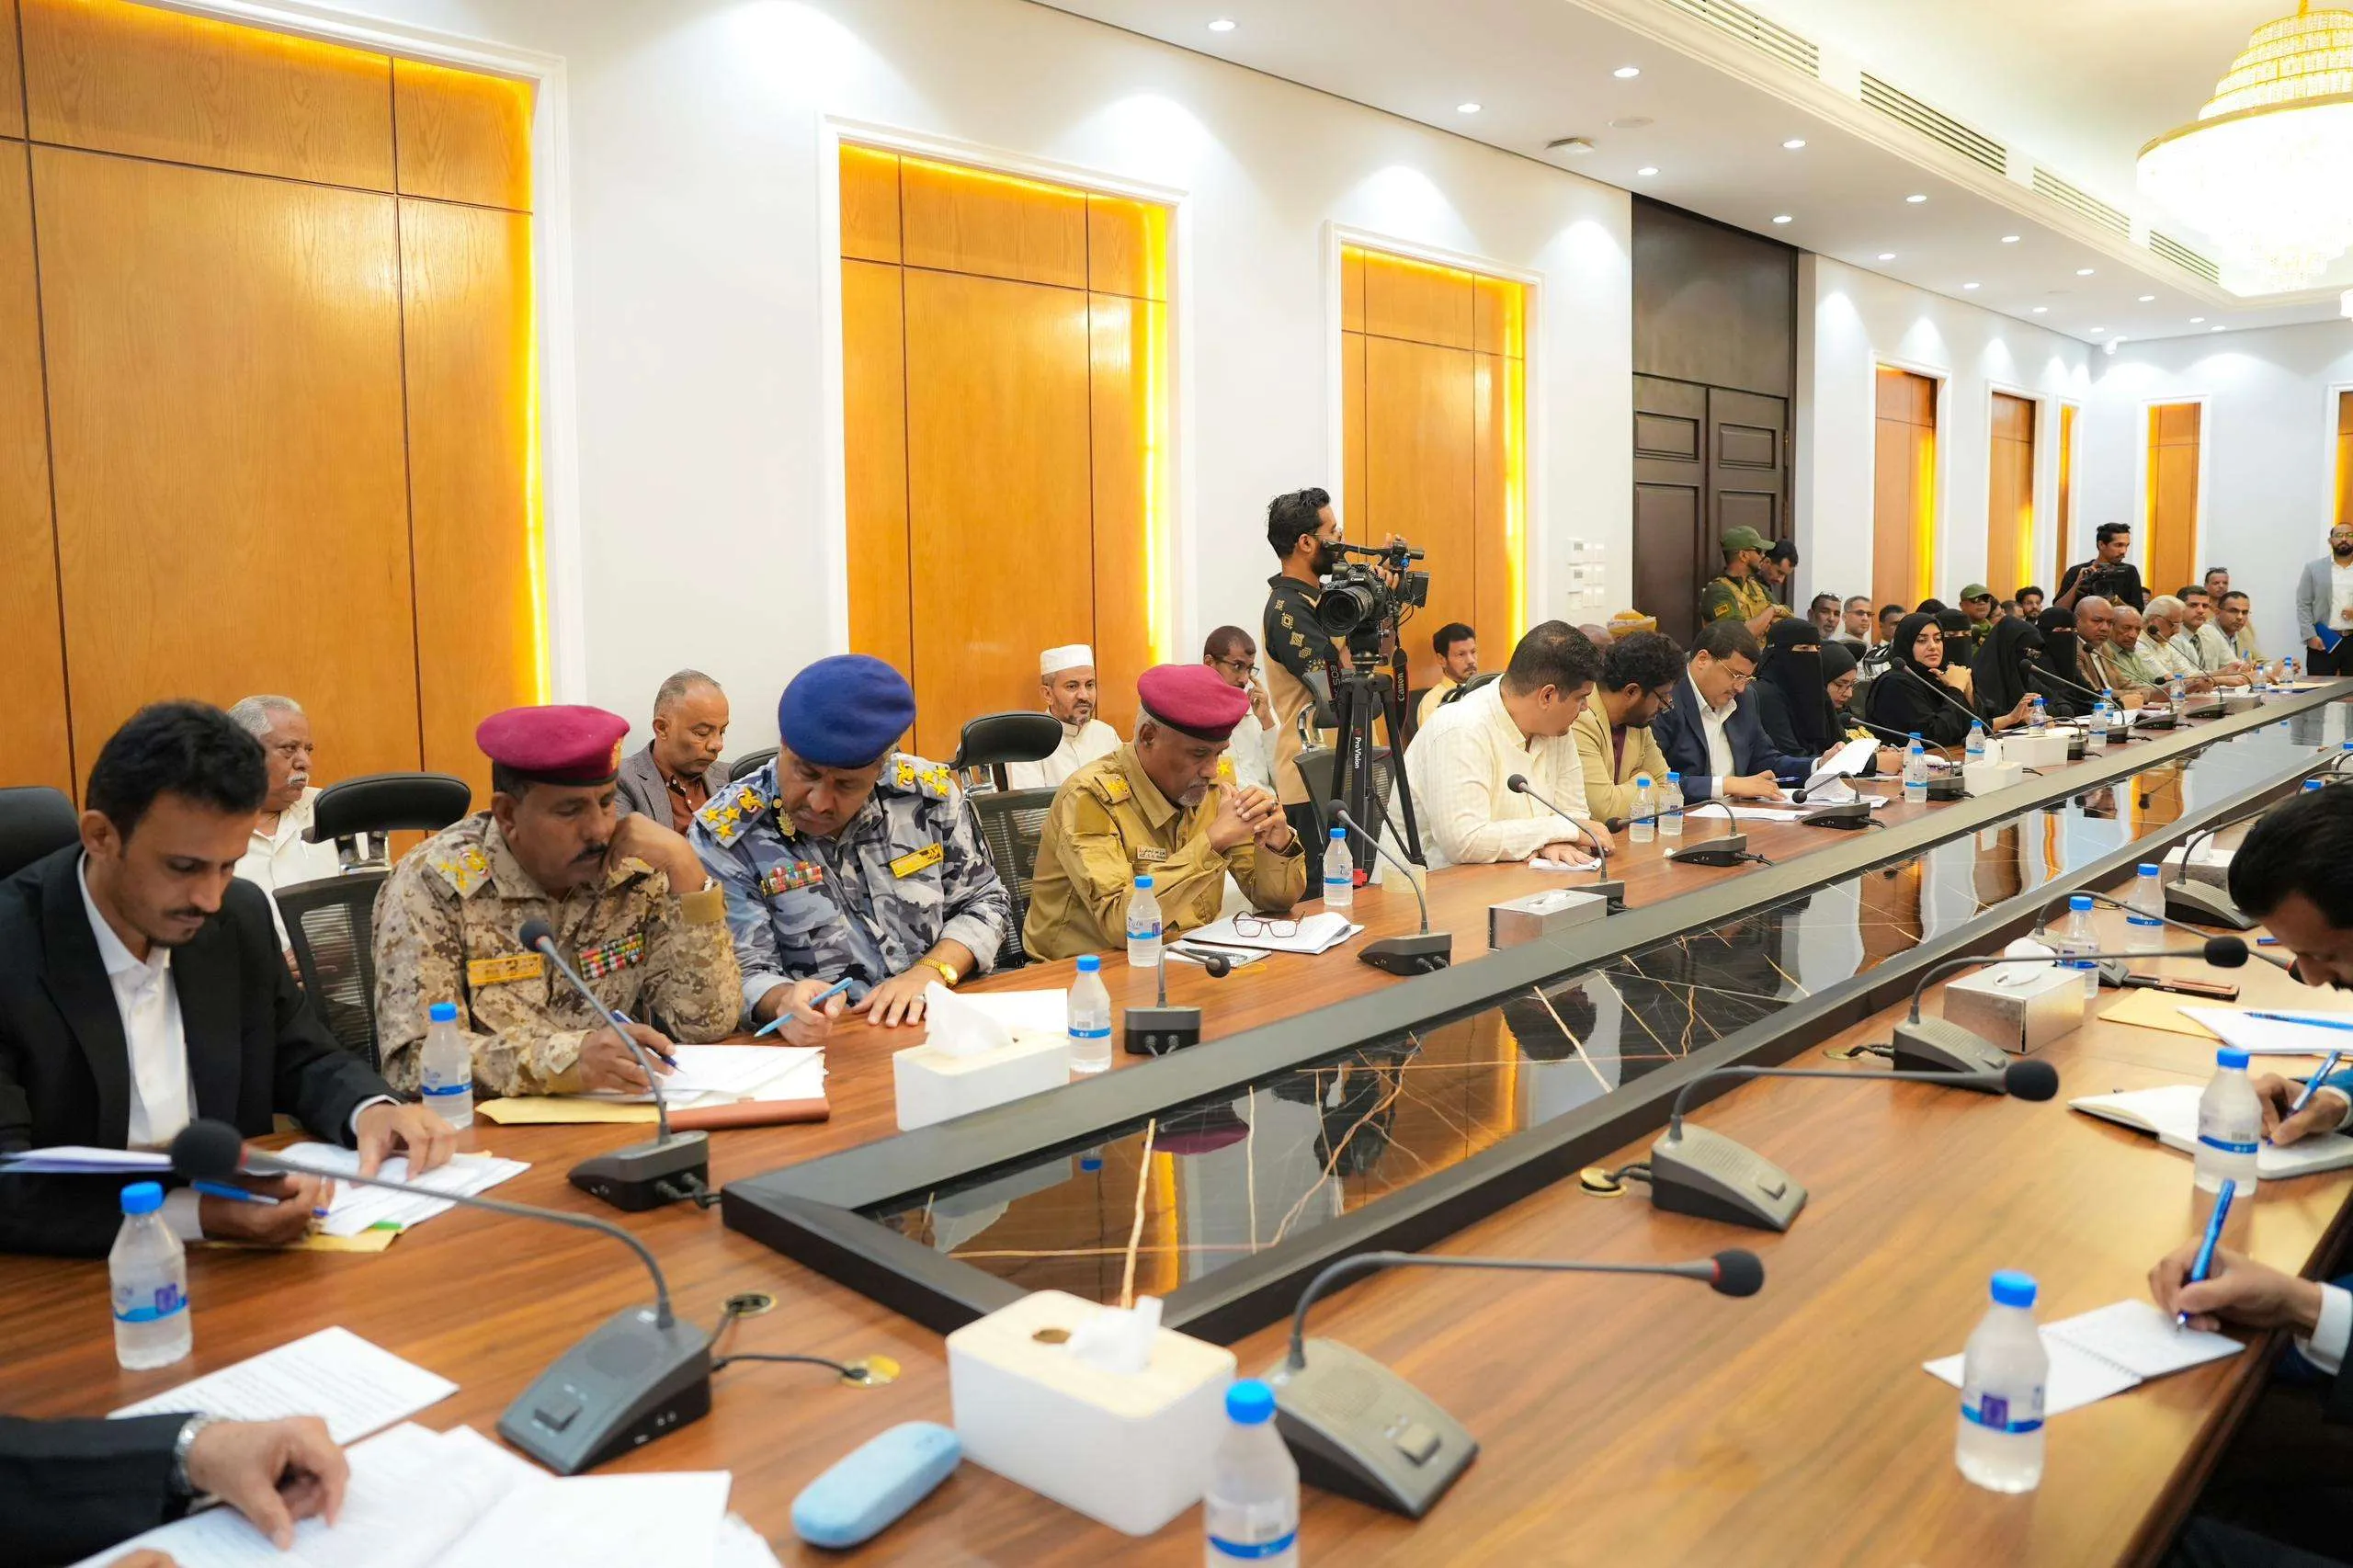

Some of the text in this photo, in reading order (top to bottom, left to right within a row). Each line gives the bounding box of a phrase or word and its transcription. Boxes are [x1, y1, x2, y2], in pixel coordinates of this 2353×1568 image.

[1330, 665, 1341, 687] EOS
[1397, 672, 1405, 702] Canon
[1354, 736, 1362, 769] ProVision
